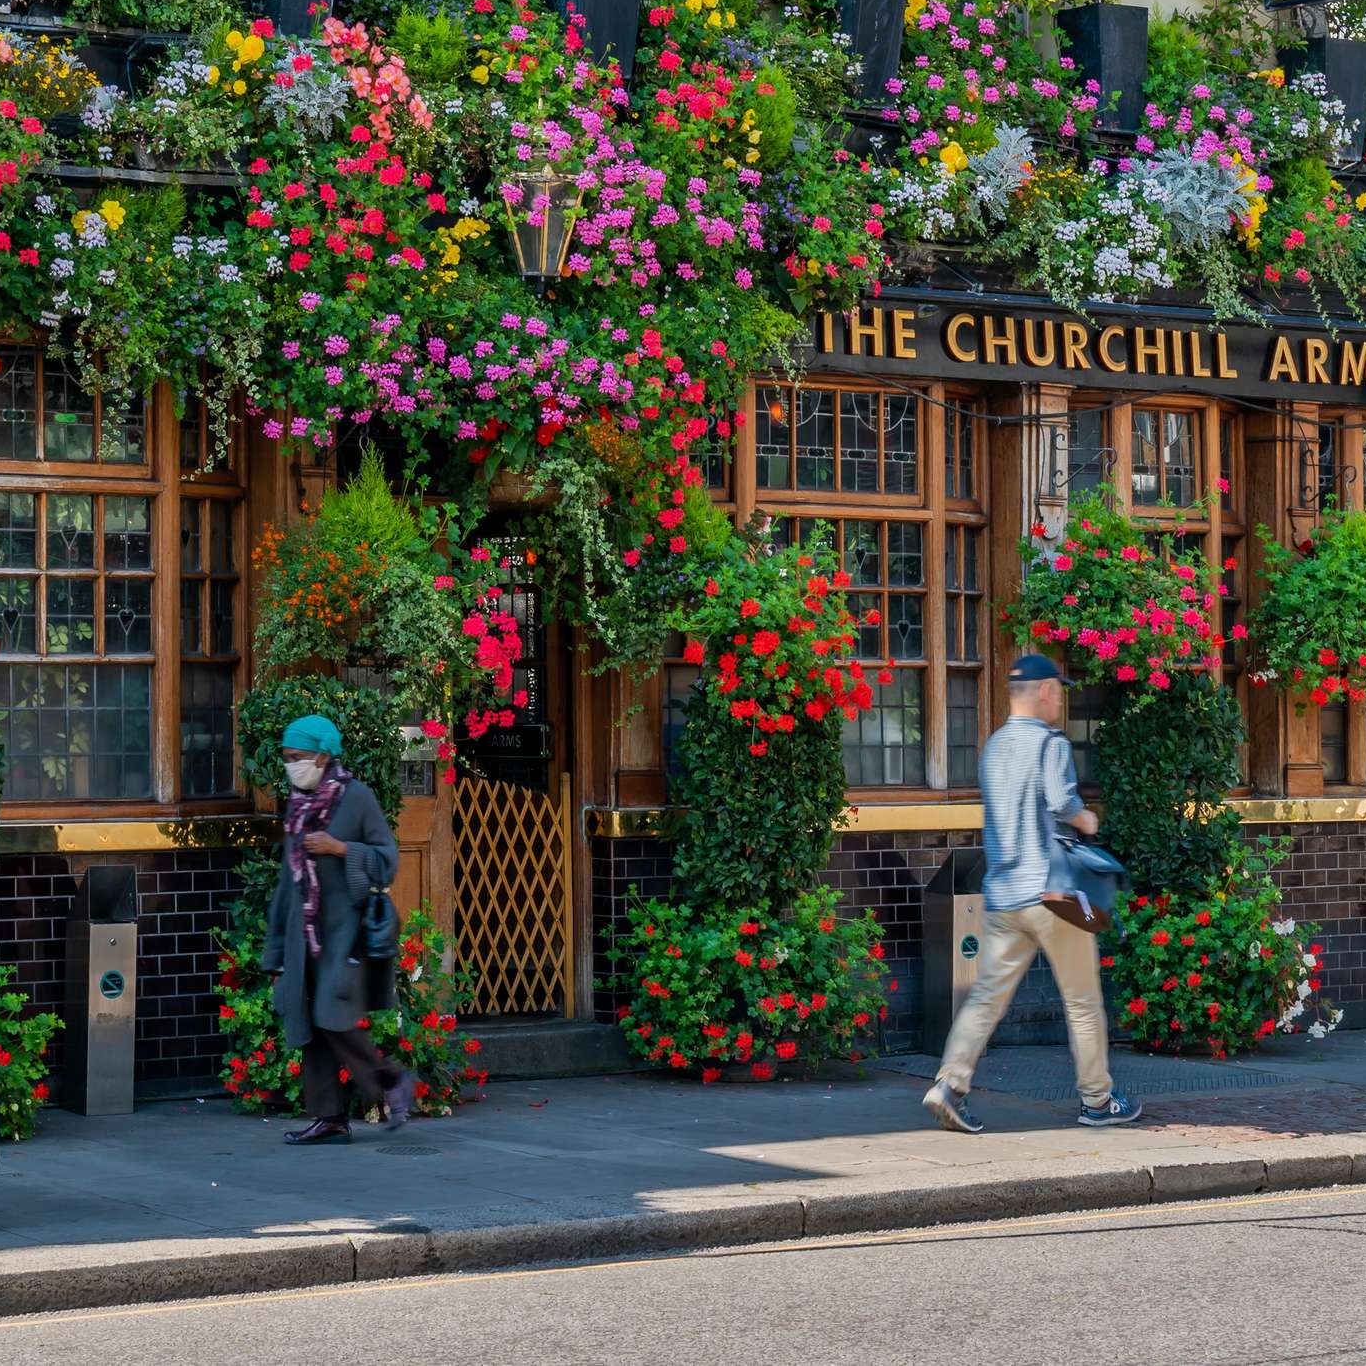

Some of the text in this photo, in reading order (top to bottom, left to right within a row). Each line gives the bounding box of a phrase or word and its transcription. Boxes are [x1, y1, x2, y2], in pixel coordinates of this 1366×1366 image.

[817, 307, 917, 359] THE
[945, 312, 1237, 378] CHURCHILL
[491, 734, 522, 748] ARMS
